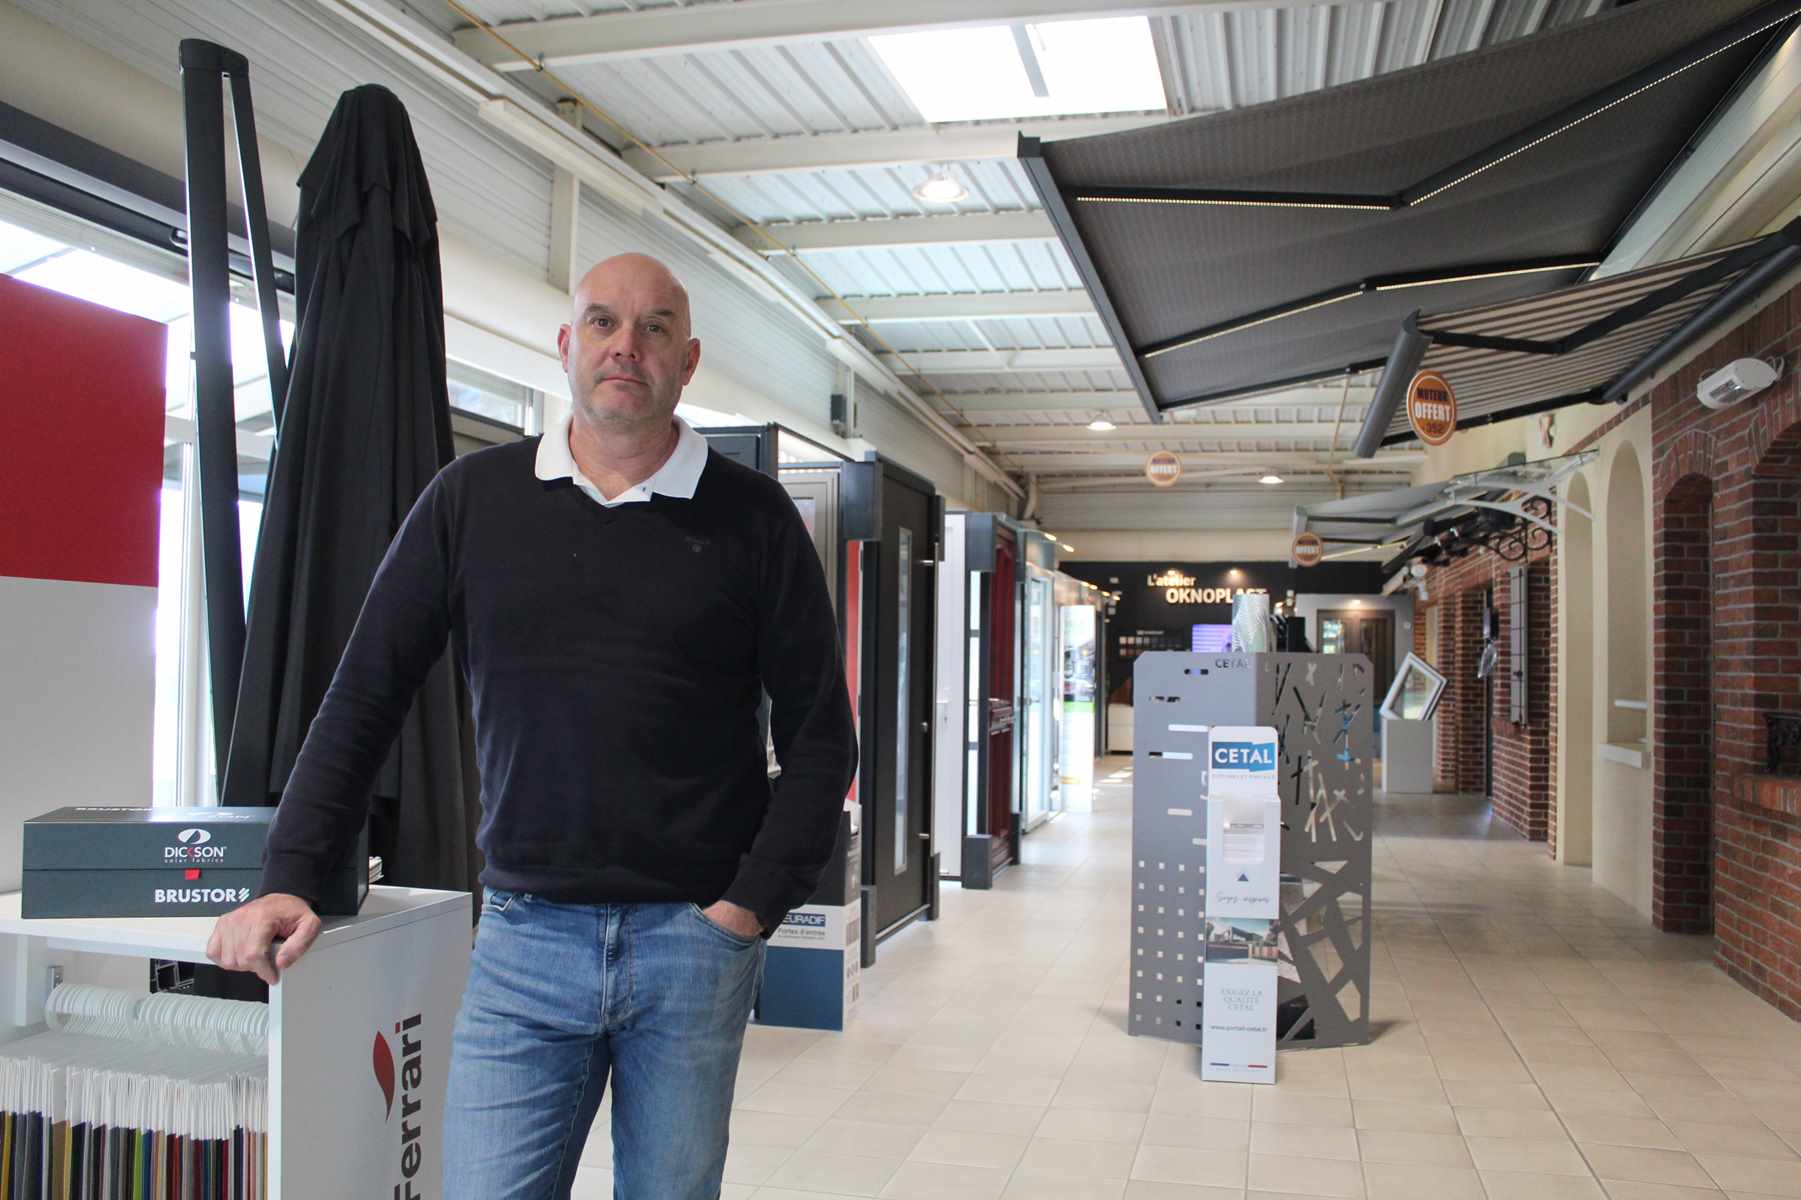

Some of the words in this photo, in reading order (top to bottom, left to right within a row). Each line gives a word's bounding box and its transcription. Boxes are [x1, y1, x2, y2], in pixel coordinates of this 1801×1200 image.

[1414, 401, 1451, 422] OFFERT
[1214, 748, 1272, 764] CETAL
[154, 888, 238, 903] BRUSTOR
[394, 1013, 422, 1200] Ferrari
